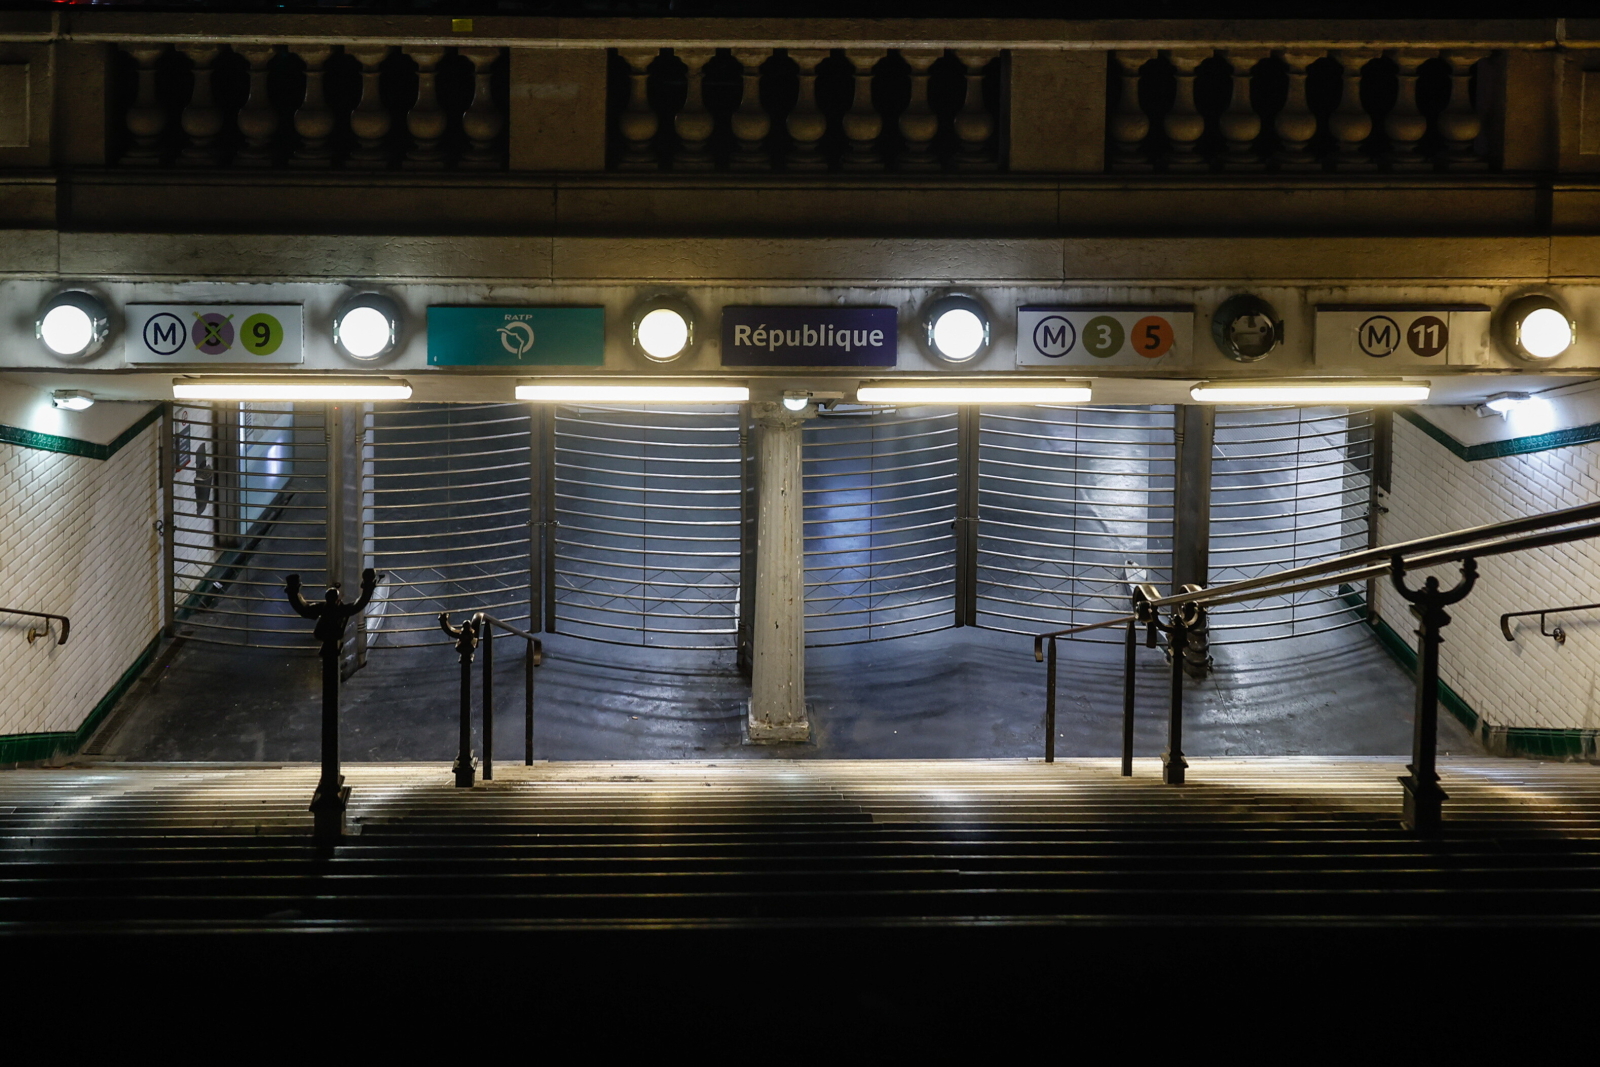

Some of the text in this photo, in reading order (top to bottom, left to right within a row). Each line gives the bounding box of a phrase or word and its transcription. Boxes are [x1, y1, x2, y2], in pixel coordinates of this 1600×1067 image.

[153, 322, 271, 348] M 8 9
[734, 324, 884, 352] République
[1043, 324, 1161, 350] M 3 5
[1368, 324, 1440, 349] M 11
